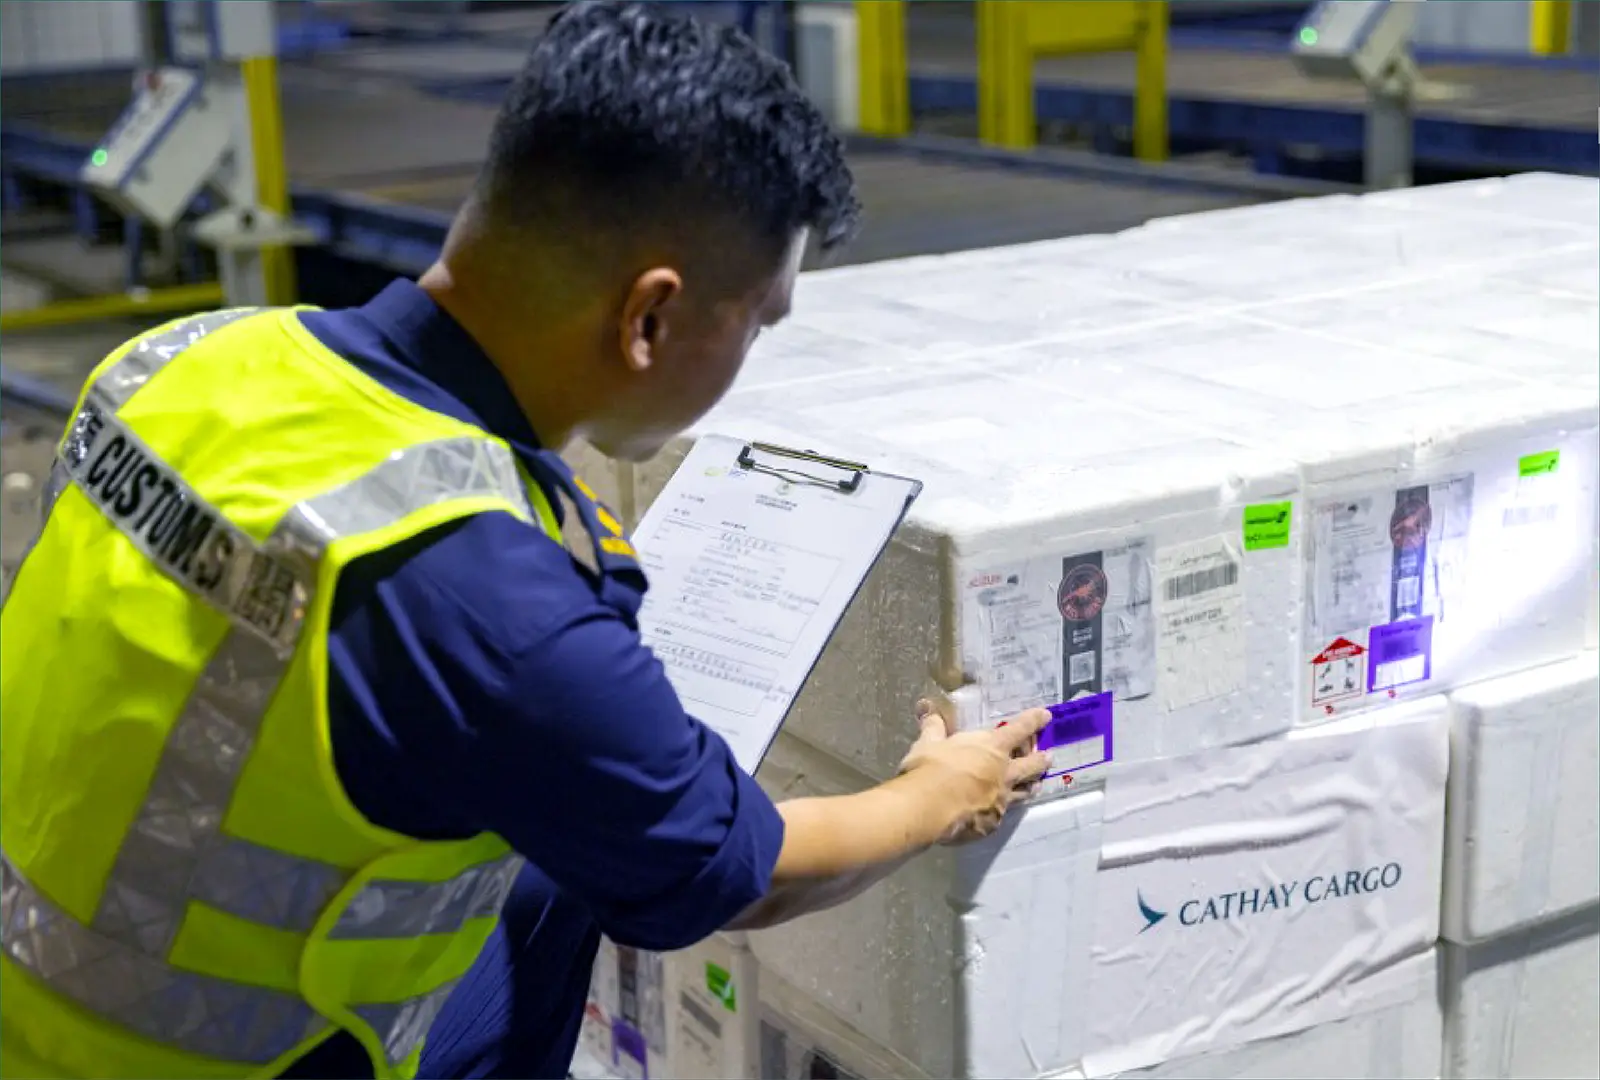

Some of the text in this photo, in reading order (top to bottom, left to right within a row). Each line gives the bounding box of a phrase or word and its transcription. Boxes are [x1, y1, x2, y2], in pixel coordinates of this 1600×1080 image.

[87, 434, 235, 590] CUSTOMS
[1178, 861, 1402, 926] CATHAY CARGO
